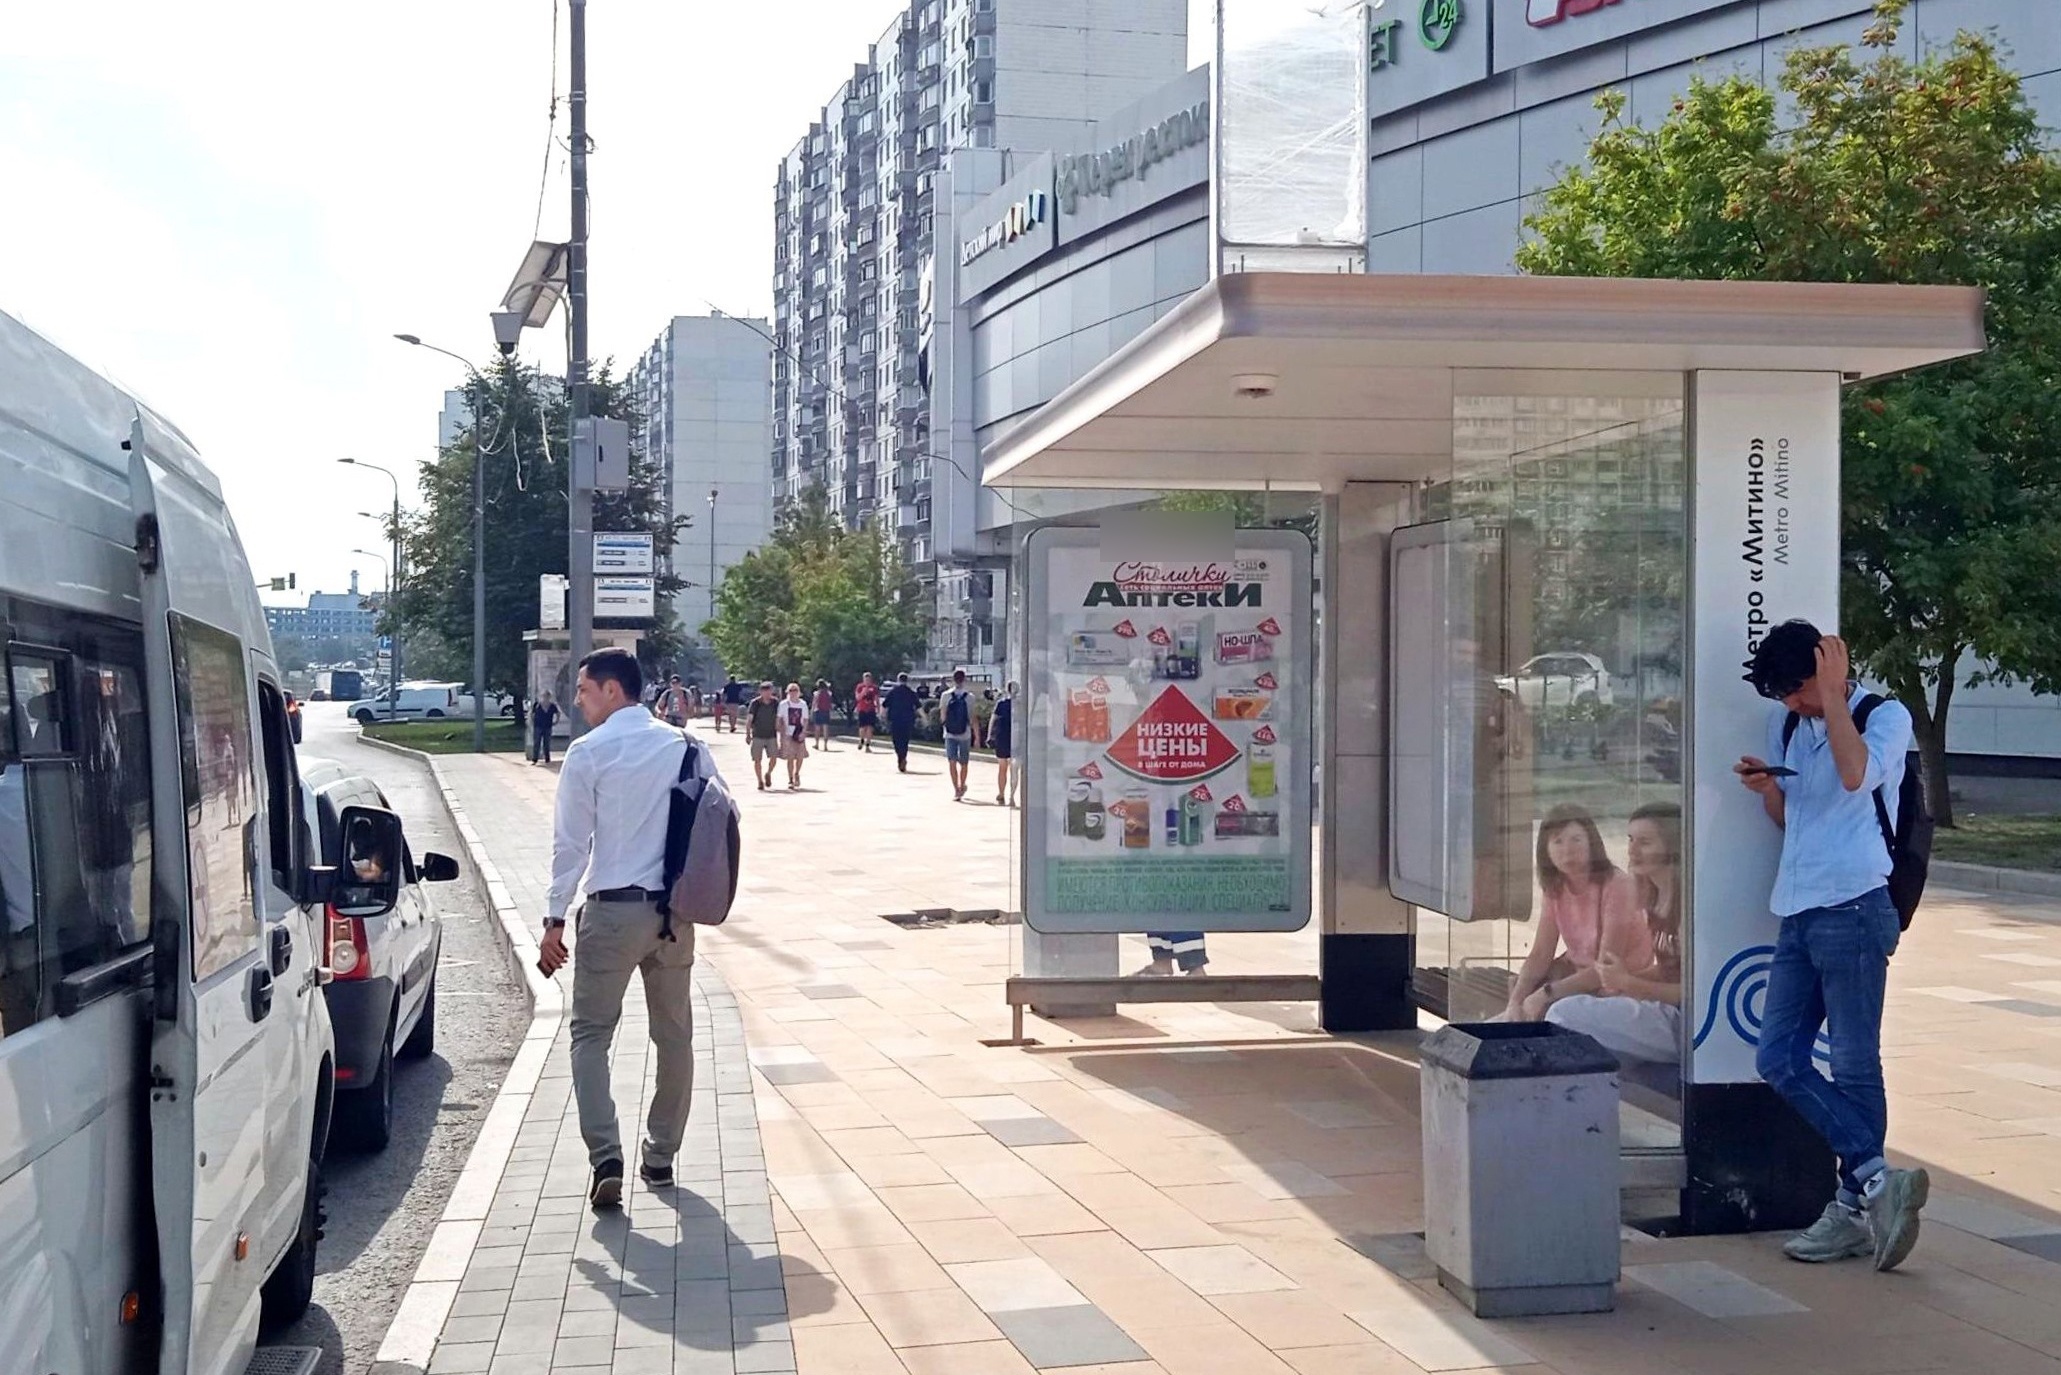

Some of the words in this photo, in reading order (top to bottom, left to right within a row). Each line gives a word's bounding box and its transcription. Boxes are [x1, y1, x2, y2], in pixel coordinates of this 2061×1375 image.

[1773, 438, 1789, 500] Mitino
[1742, 438, 1765, 582] «Митино»
[1773, 507, 1789, 565] Metro
[1137, 722, 1208, 737] НИЗКИЕ
[1138, 738, 1208, 759] ЦЕНЫ
[1181, 761, 1206, 769] ДОМА
